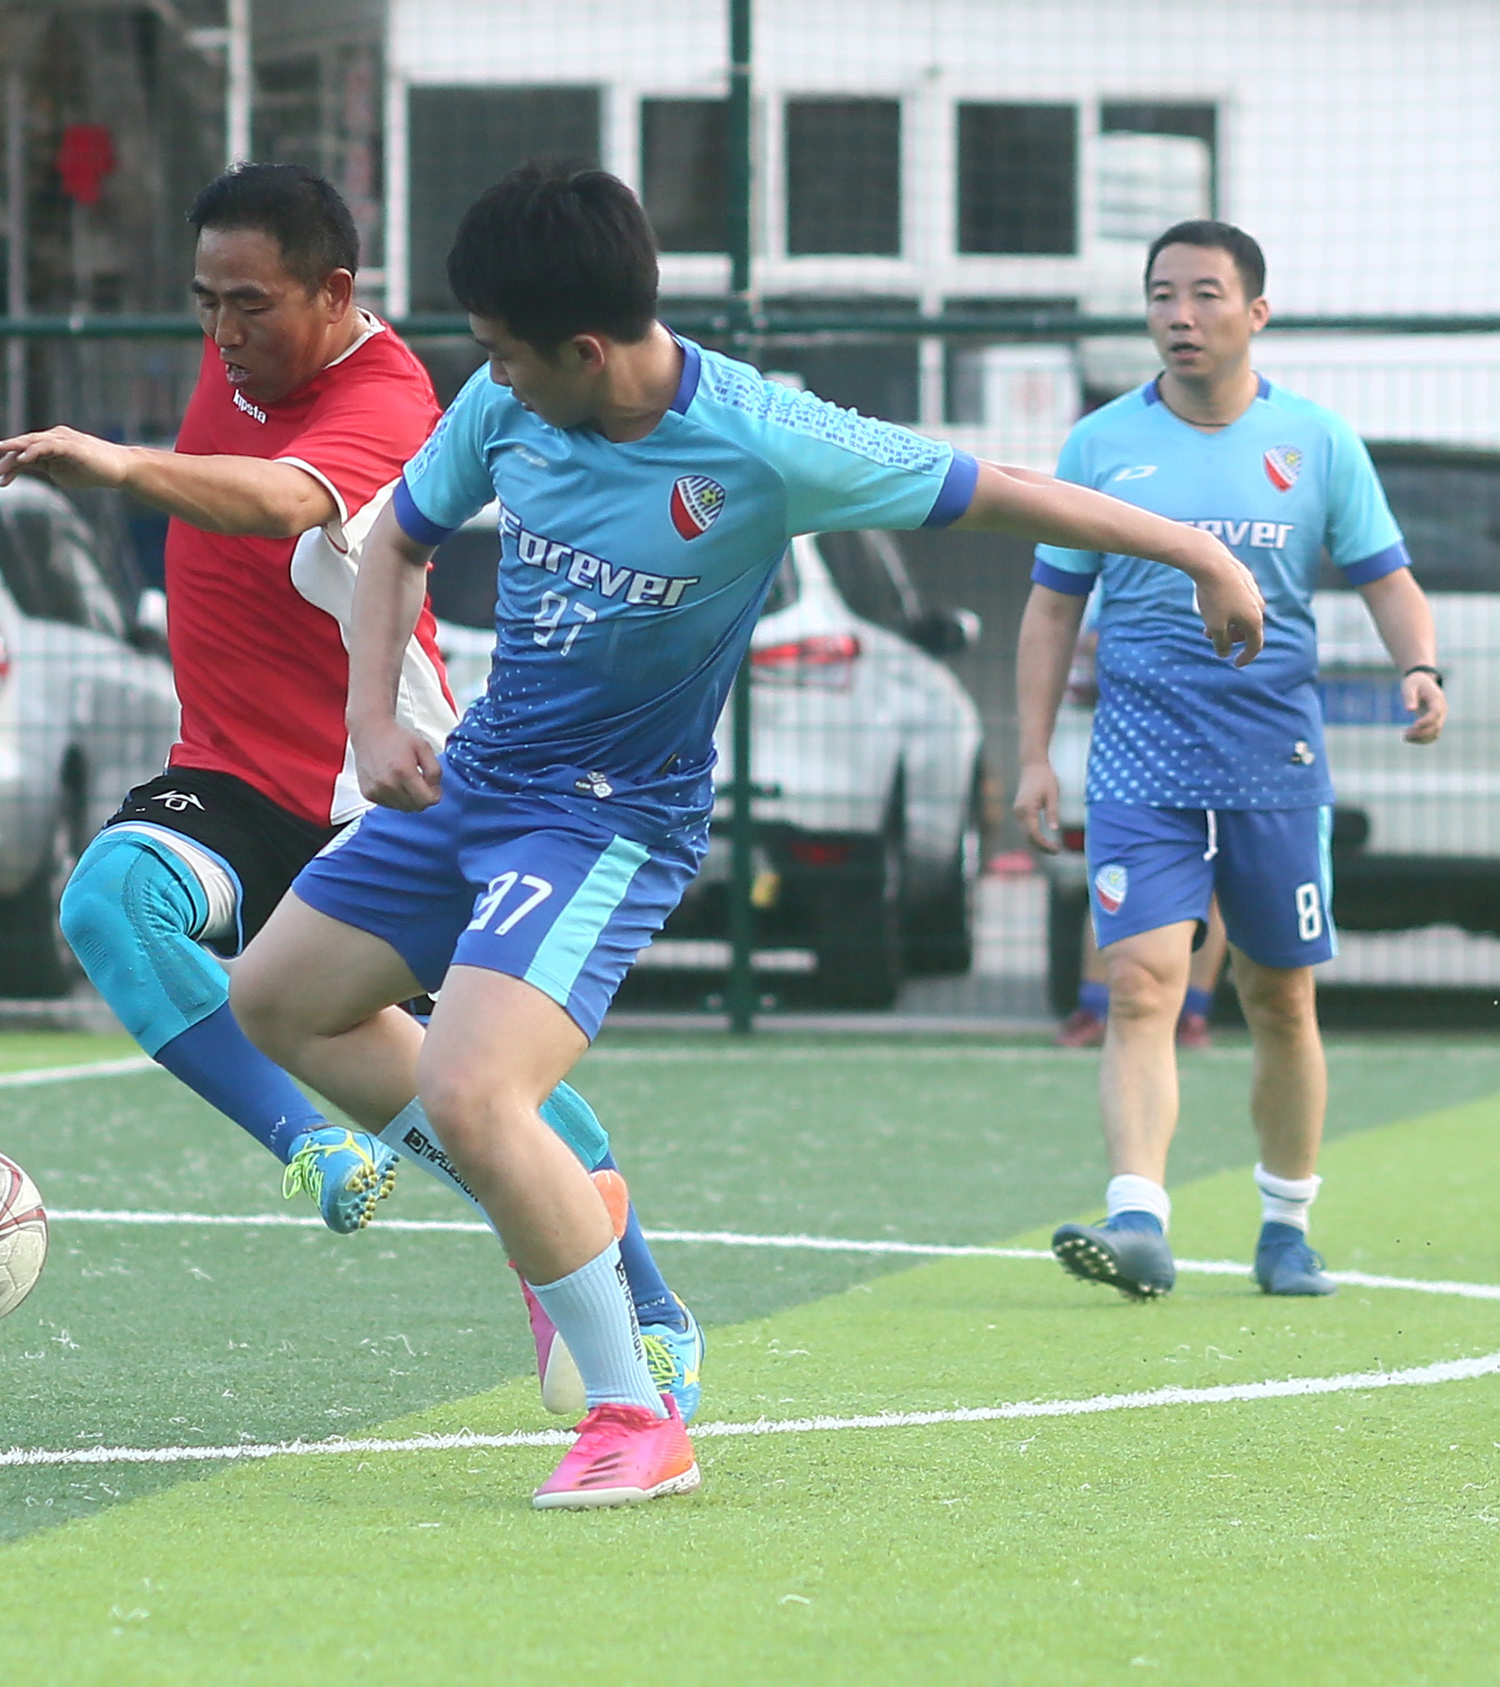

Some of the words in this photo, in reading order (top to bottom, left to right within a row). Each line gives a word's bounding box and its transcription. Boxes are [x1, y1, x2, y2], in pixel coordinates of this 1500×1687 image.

[500, 505, 700, 607] Forever
[533, 590, 598, 657] 97
[1295, 882, 1323, 941] 8
